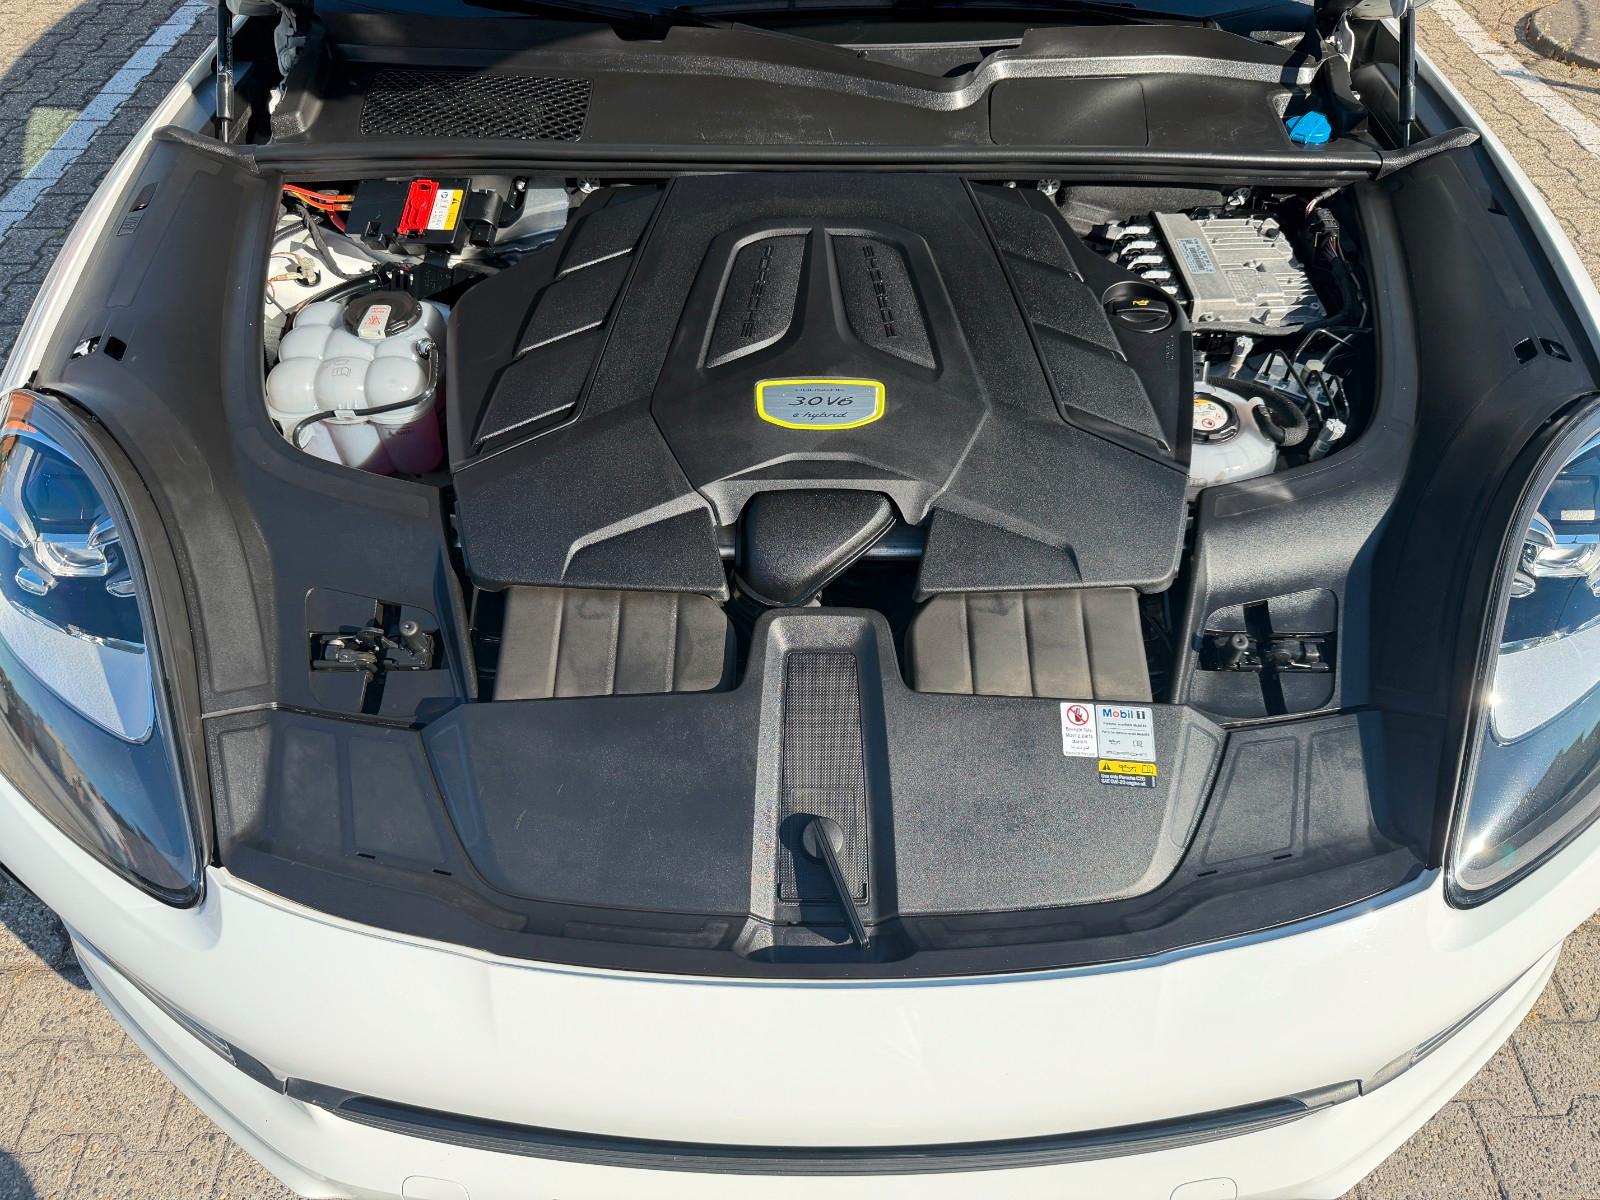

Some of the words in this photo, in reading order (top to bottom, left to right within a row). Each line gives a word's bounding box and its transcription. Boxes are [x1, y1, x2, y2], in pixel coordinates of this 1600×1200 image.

[741, 246, 772, 337] PORSCHE
[862, 245, 897, 337] PORSCHE
[788, 396, 823, 406] 3.0
[827, 396, 854, 406] V6
[1103, 708, 1134, 719] Mobil
[1137, 711, 1145, 720] 1
